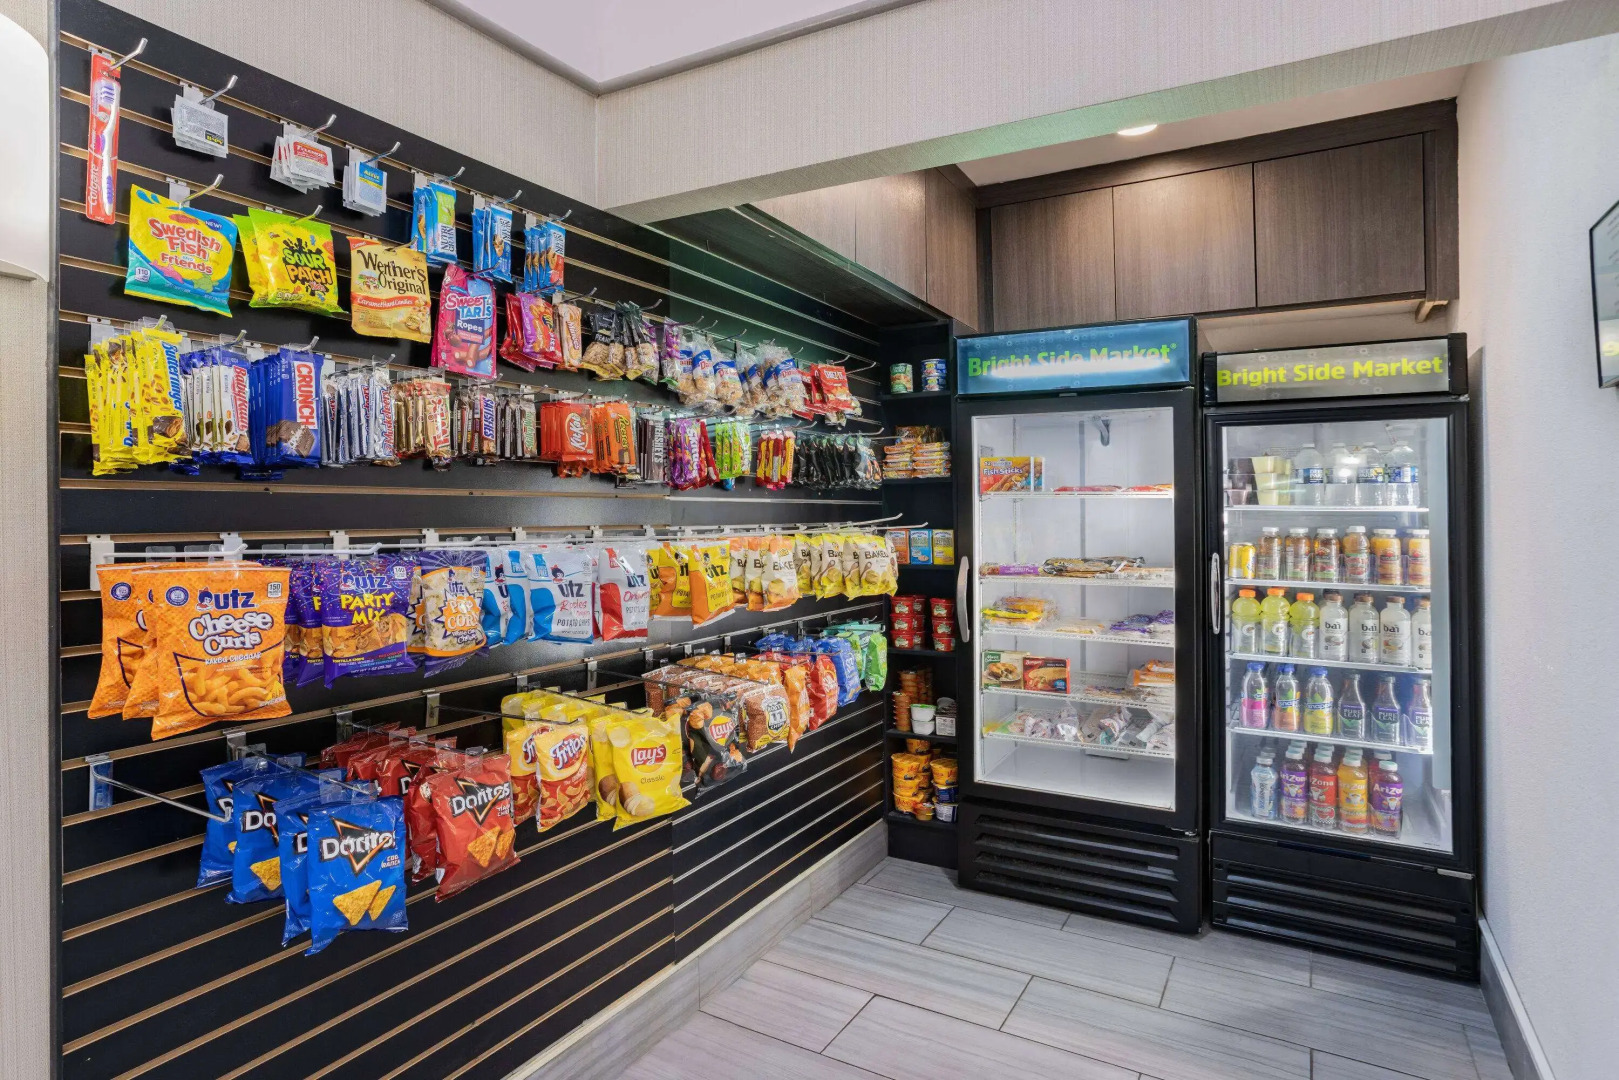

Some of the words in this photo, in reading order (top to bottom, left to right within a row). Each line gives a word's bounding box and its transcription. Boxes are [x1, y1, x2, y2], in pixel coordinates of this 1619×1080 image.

[88, 165, 100, 206] Colgate
[148, 218, 222, 252] Swedish
[165, 235, 209, 260] Fish
[283, 247, 326, 269] SOUR
[160, 252, 213, 274] Friends
[286, 264, 333, 285] PATCH
[357, 250, 426, 282] Werther's
[378, 272, 426, 295] Original
[456, 320, 483, 333] Ropes
[968, 354, 1031, 377] Bright
[1037, 350, 1085, 369] Side
[1217, 366, 1287, 387] Bright
[1294, 363, 1345, 382] Side
[1353, 356, 1443, 379] Market
[162, 340, 183, 411] Butterfinger
[295, 363, 316, 425] CRUNCH
[483, 398, 494, 440] SATISFIES
[999, 466, 1023, 475] Sticks
[772, 560, 795, 571] BAKE
[269, 583, 281, 591] 150
[340, 591, 395, 609] PARTY
[450, 600, 473, 614] POP
[189, 611, 274, 641] Cheese
[352, 608, 386, 625] MIX
[447, 612, 479, 629] CORN
[203, 631, 263, 656] Curls
[770, 711, 784, 721] 11
[550, 734, 586, 770] Fritos
[640, 775, 665, 784] Classic
[452, 781, 510, 815] Doritos
